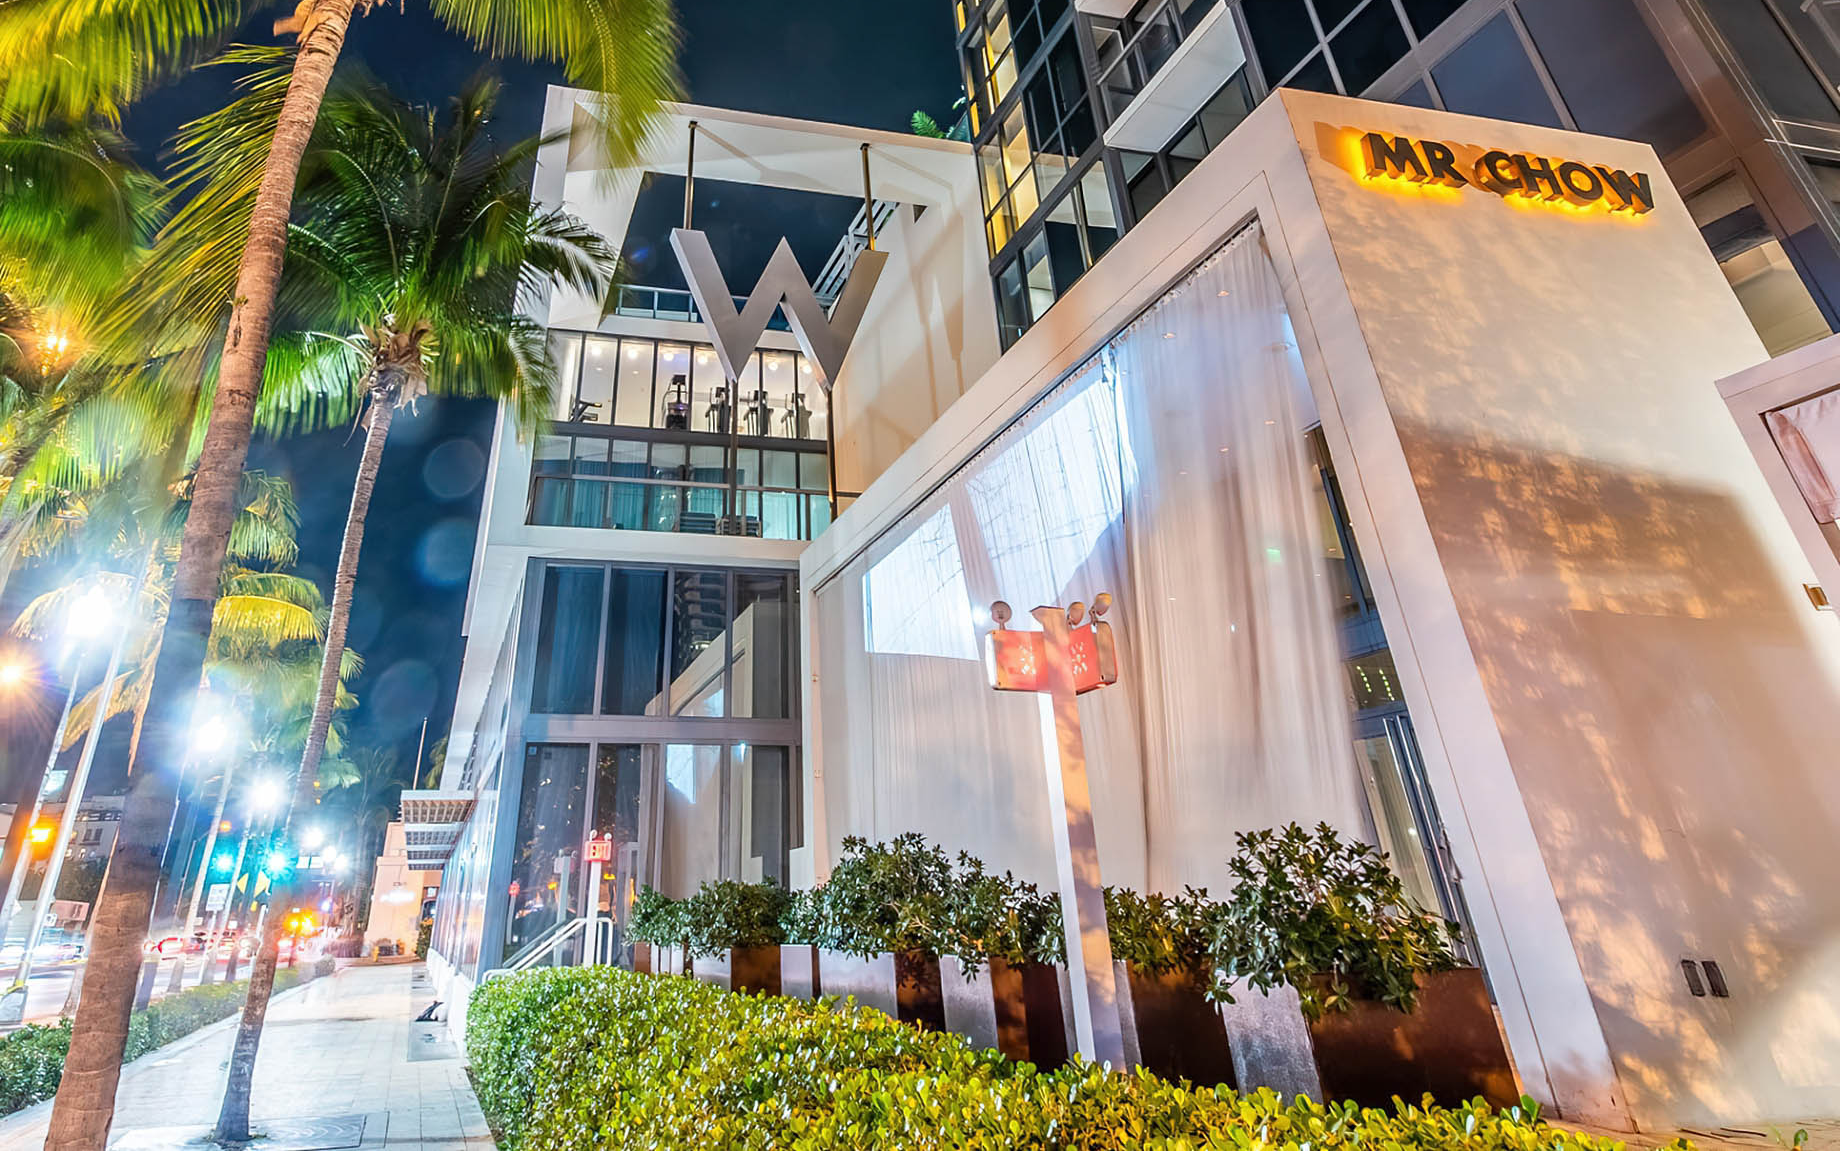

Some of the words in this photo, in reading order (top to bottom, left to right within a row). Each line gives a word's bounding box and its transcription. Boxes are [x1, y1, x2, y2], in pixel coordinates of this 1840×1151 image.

[1361, 133, 1467, 188] MR
[1476, 151, 1654, 214] CHOW
[670, 229, 889, 391] W
